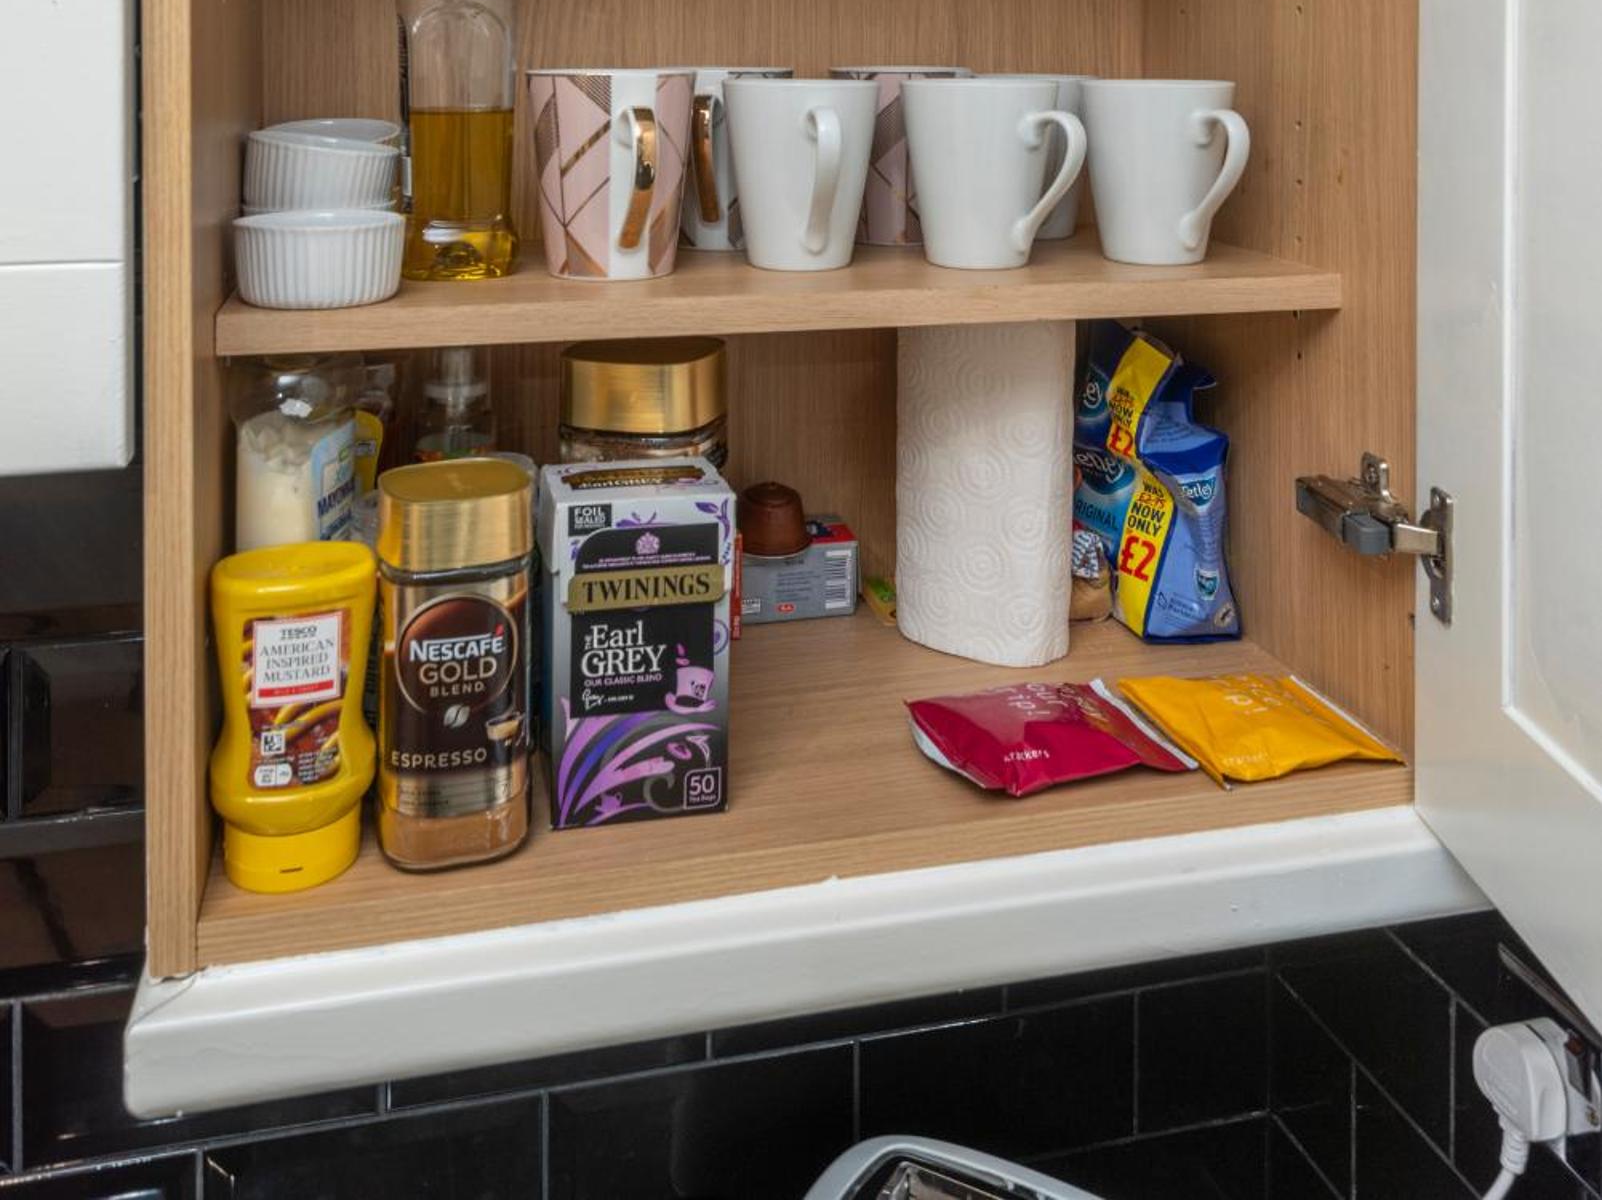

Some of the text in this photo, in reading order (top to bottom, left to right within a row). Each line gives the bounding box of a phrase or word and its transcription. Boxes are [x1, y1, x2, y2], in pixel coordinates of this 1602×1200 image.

[574, 506, 602, 517] FOIL
[1074, 499, 1118, 530] RIGINAL
[1131, 502, 1166, 523] NOW
[1127, 515, 1162, 537] ONLY
[1119, 536, 1156, 581] £2
[581, 572, 711, 603] TWININGS
[280, 625, 317, 637] TESCO
[591, 620, 644, 648] Earl
[260, 638, 334, 657] AMERICAN
[409, 625, 505, 662] NESCAFÉ
[266, 652, 329, 670] INSPIRED
[418, 655, 498, 686] GOLD
[581, 644, 667, 678] GREY
[262, 665, 331, 683] MUSTARD
[583, 673, 662, 687] OUR CLASSIC BLEND
[429, 682, 486, 698] BLEND
[391, 747, 487, 770] ESPRESSO
[689, 775, 715, 796] 50
